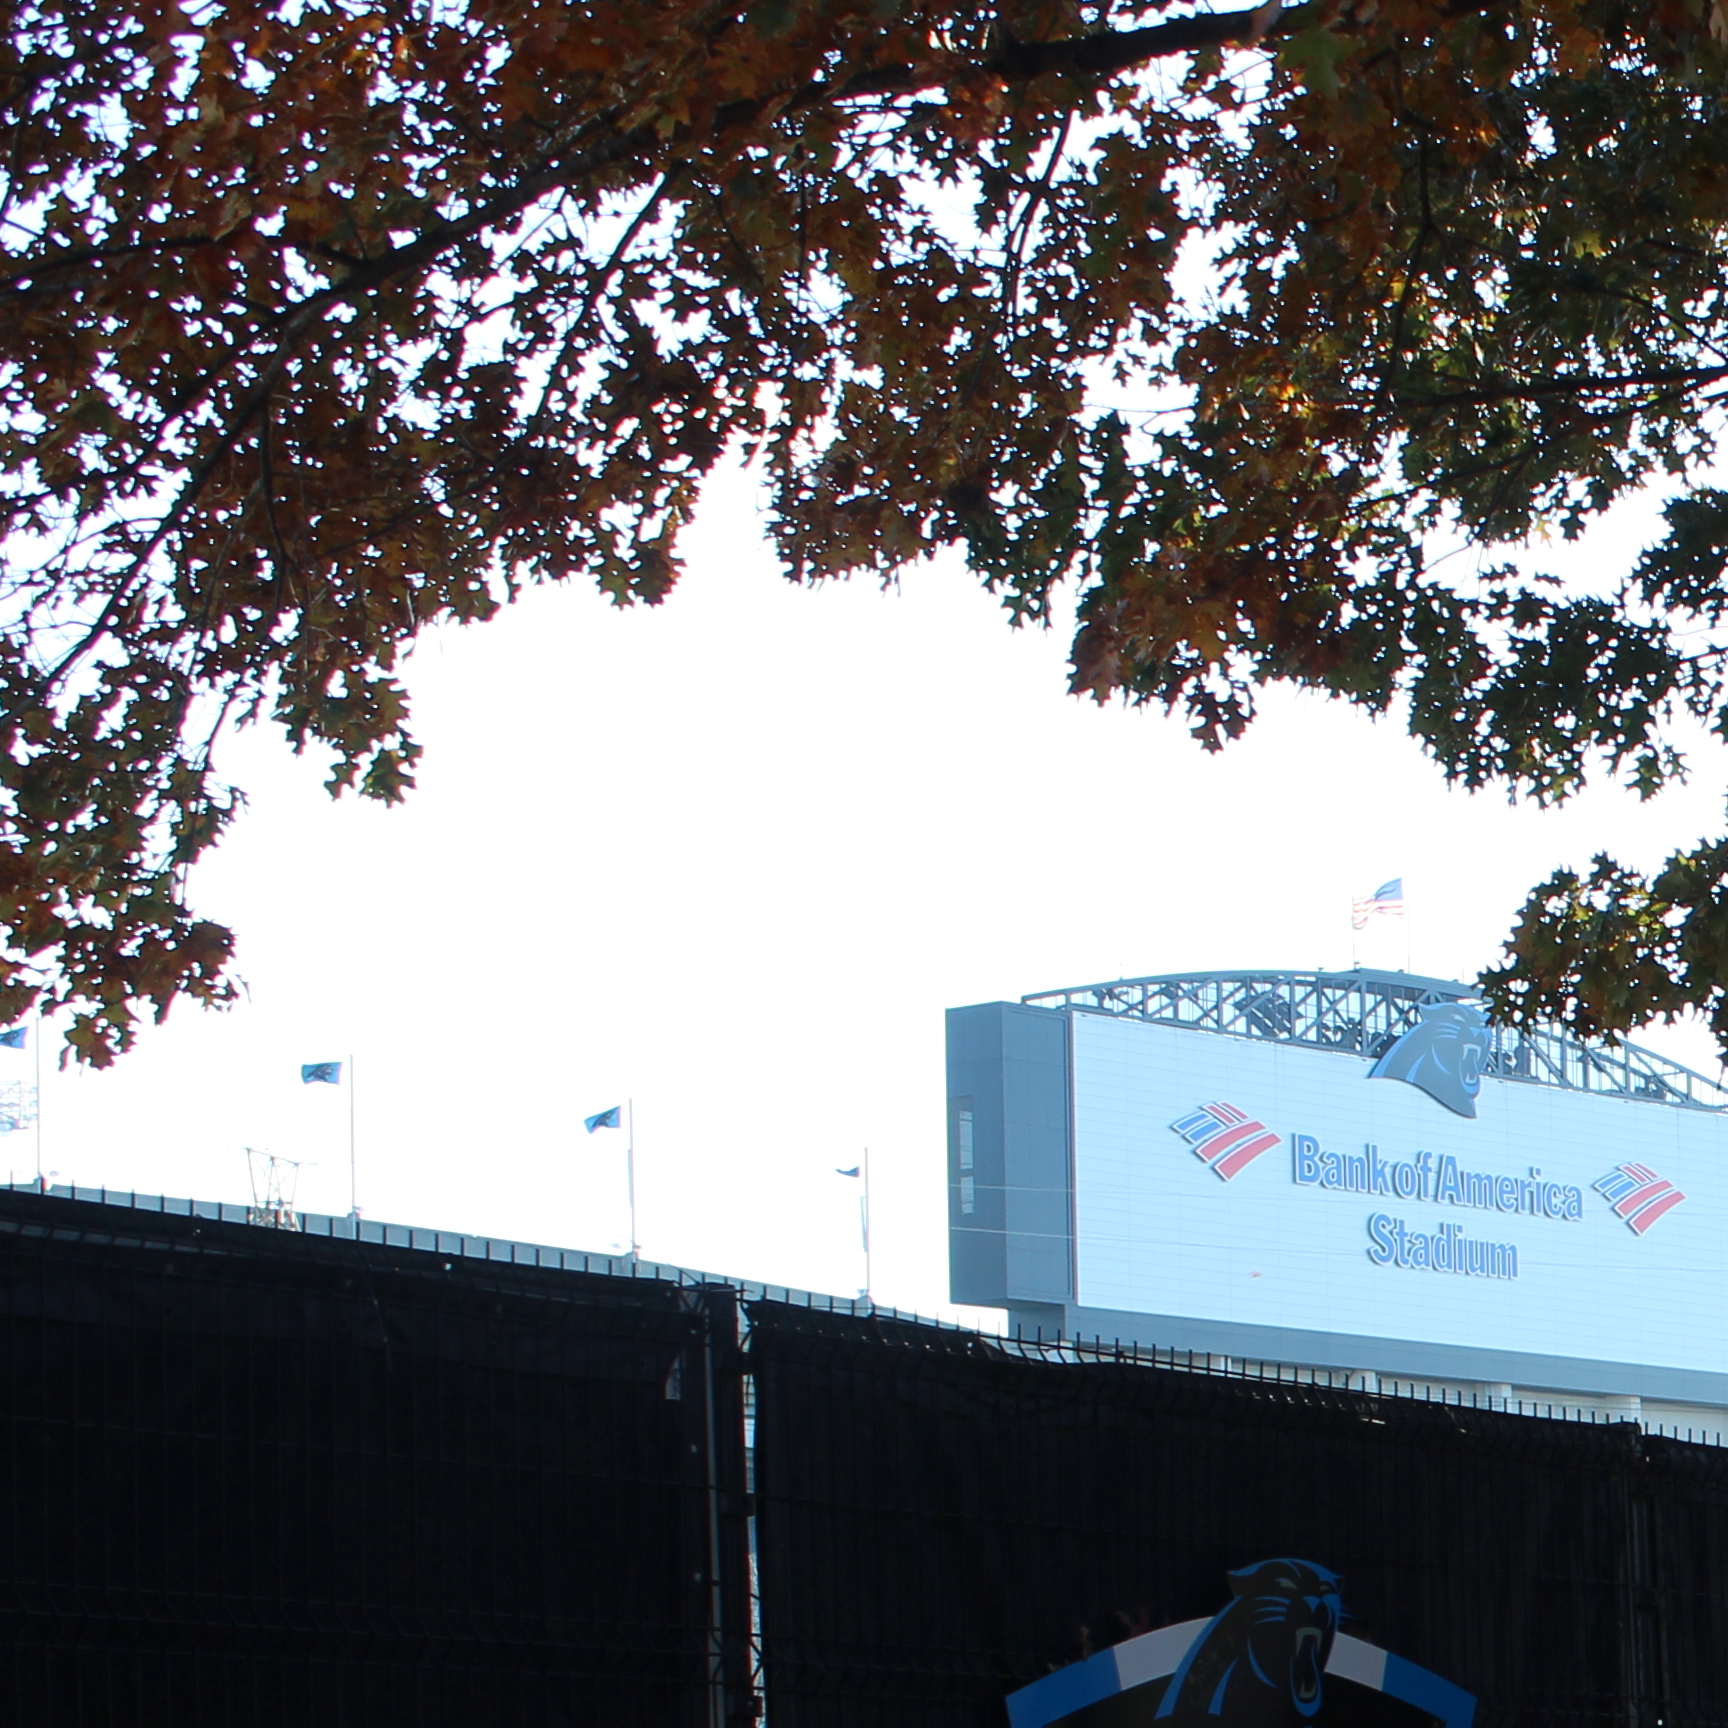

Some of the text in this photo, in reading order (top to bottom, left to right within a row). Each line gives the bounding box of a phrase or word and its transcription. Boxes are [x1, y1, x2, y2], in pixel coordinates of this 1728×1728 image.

[1292, 1132, 1584, 1221] Bank of America
[1368, 1211, 1519, 1280] Stadium
